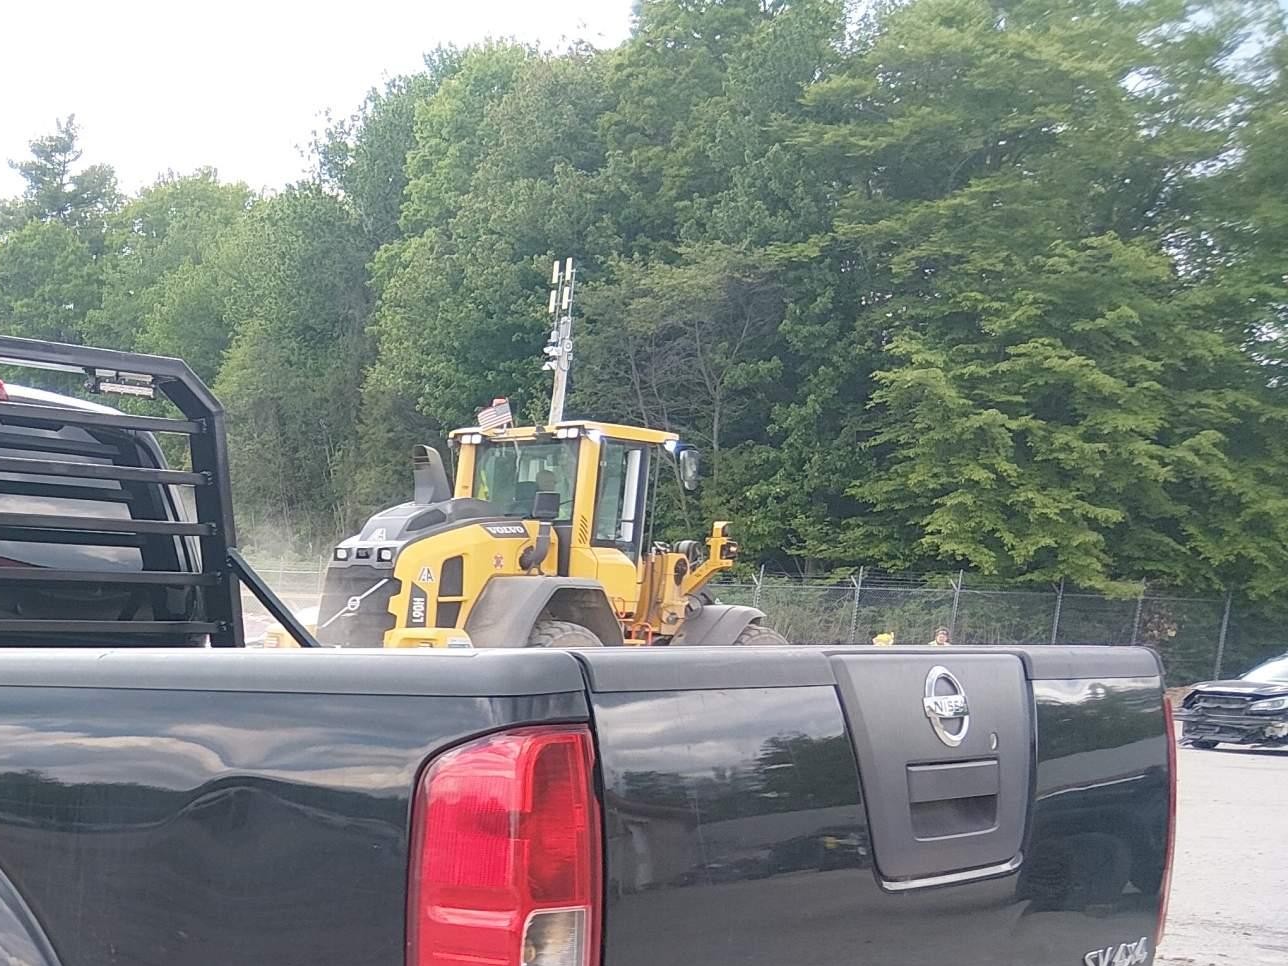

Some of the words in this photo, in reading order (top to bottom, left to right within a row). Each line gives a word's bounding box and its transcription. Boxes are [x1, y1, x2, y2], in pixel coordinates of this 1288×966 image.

[487, 525, 525, 534] VOLVO
[411, 597, 425, 623] L90H
[933, 700, 967, 714] NISS
